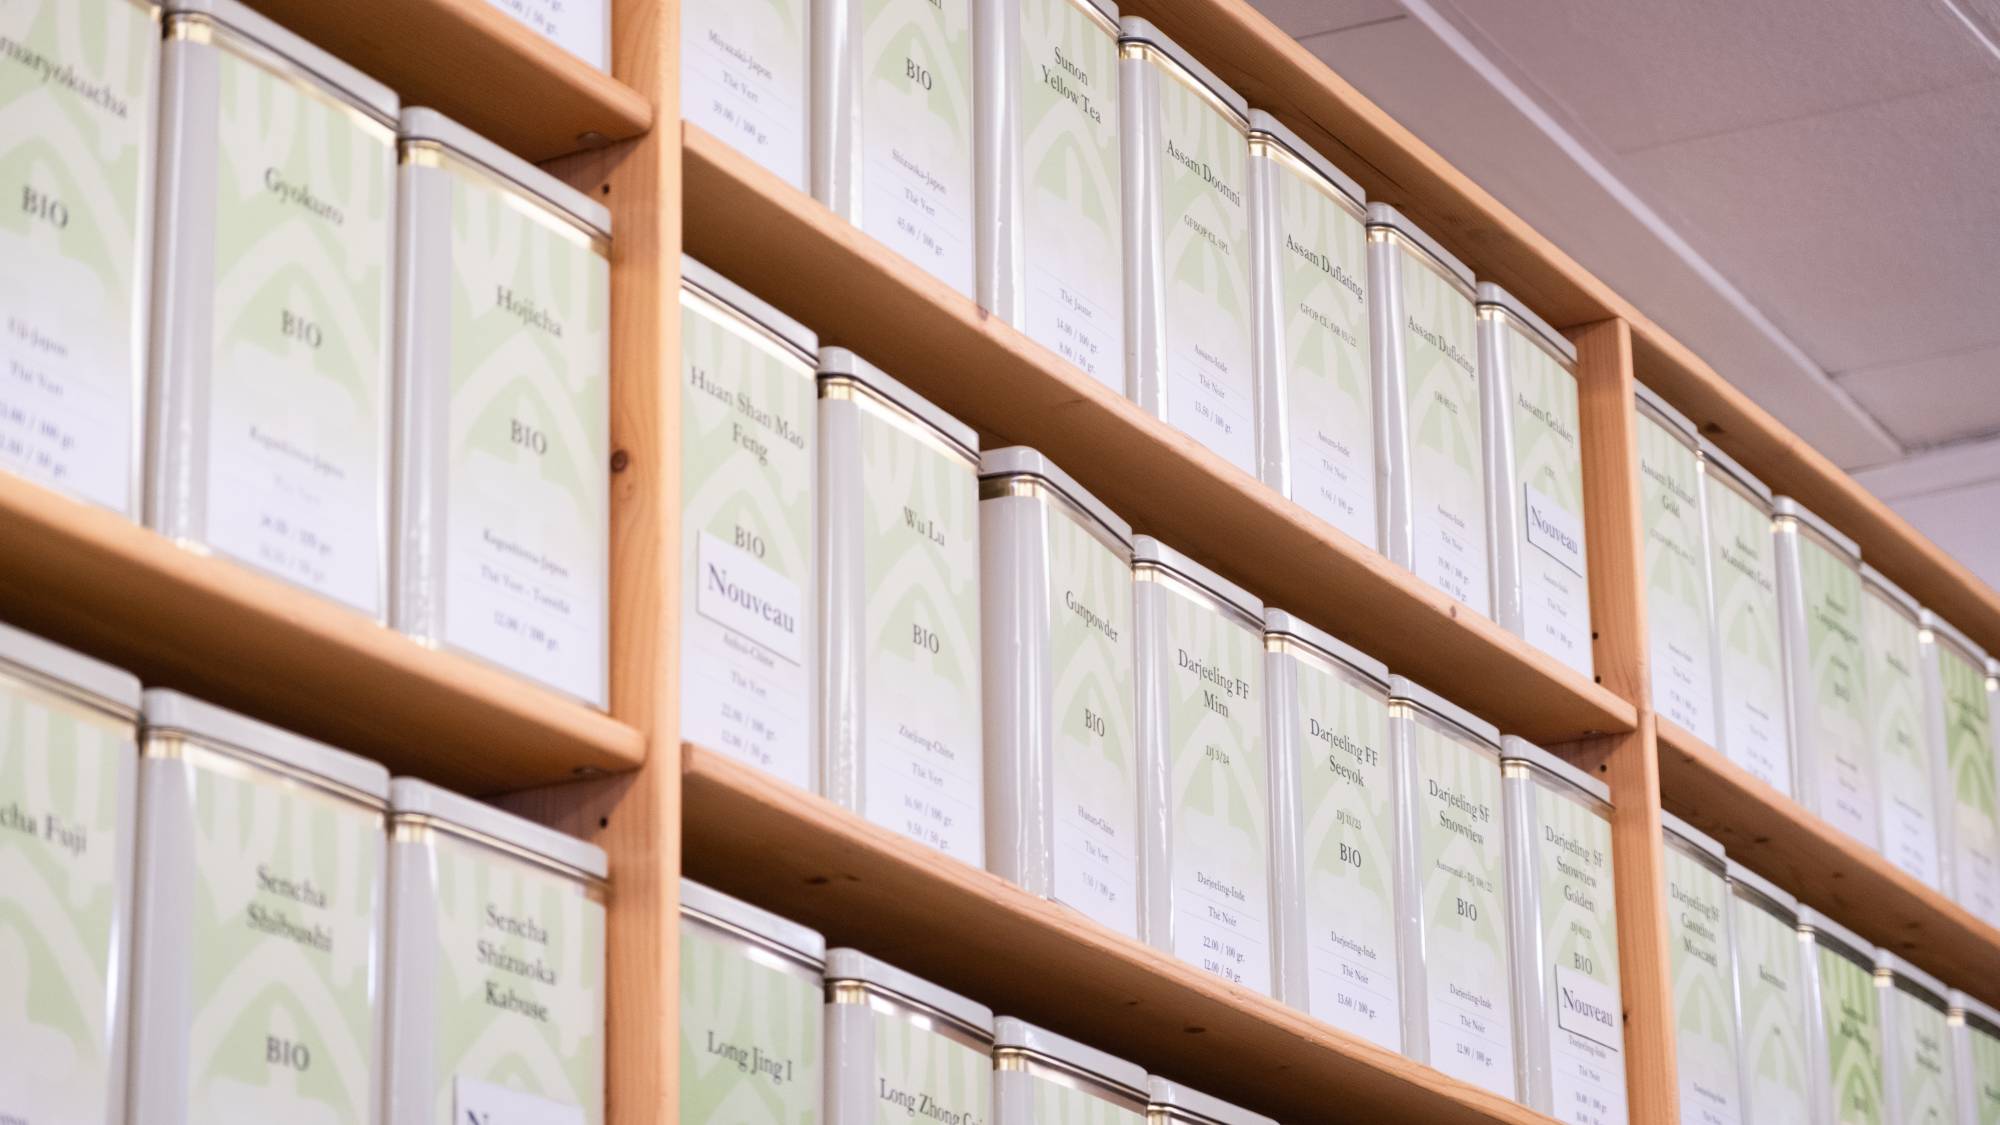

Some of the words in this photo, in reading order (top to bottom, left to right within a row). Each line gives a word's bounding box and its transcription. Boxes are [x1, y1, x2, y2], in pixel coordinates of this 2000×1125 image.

[906, 57, 932, 91] BIO
[1054, 46, 1089, 87] Sunon
[1042, 64, 1078, 105] Yellow
[1081, 94, 1102, 124] Tea
[1166, 138, 1201, 176] Assam
[1202, 162, 1241, 208] Doomni
[21, 185, 69, 230] BIO
[264, 165, 344, 226] Gyokuro
[1286, 233, 1319, 267] Assam
[1321, 253, 1364, 304] Duflating
[281, 309, 323, 350] BIO
[496, 285, 563, 338] Hojicha
[1408, 315, 1437, 347] Assam
[1438, 334, 1475, 381] Duflating
[690, 365, 734, 407] Huan
[737, 392, 772, 430] Shan
[775, 414, 805, 450] Mao
[1517, 391, 1546, 424] Assam
[510, 418, 547, 455] BIO
[732, 422, 769, 467] Feng
[734, 525, 767, 560] BIO
[904, 505, 925, 536] Wu
[928, 520, 945, 547] Lu
[1531, 504, 1578, 556] Nouveau
[707, 562, 795, 634] Nouveau
[1065, 590, 1119, 643] Gunpowder
[913, 623, 940, 655] BIO
[1178, 648, 1233, 698] Darjeeling
[1236, 678, 1250, 700] FF
[1084, 708, 1105, 737] BIO
[1203, 689, 1229, 718] Mim
[1310, 718, 1363, 765] Darjeeling
[1365, 746, 1379, 768] FF
[1329, 754, 1364, 788] Seeyok
[1429, 779, 1478, 823] Darjeeling
[1478, 803, 1490, 824] SF
[45, 814, 87, 856] Fuji
[1439, 810, 1485, 846] Snowview
[1545, 825, 1590, 863] Darjeeling
[1593, 849, 1604, 868] SF
[1339, 842, 1362, 869] BIO
[1556, 855, 1598, 889] Snowview
[257, 863, 327, 909] Sencha
[1564, 884, 1595, 913] Golden
[1671, 881, 1711, 919] Darjeeling
[486, 903, 548, 946] Sencha
[1456, 897, 1478, 922] BIO
[477, 940, 556, 986] Shizuoka
[1573, 952, 1593, 976] BIO
[485, 980, 548, 1022] Kabuse
[1562, 987, 1614, 1028] Nouveau
[265, 1035, 311, 1072] BIO
[708, 1030, 748, 1072] Long
[750, 1047, 783, 1085] Jing
[879, 1077, 916, 1118] Long
